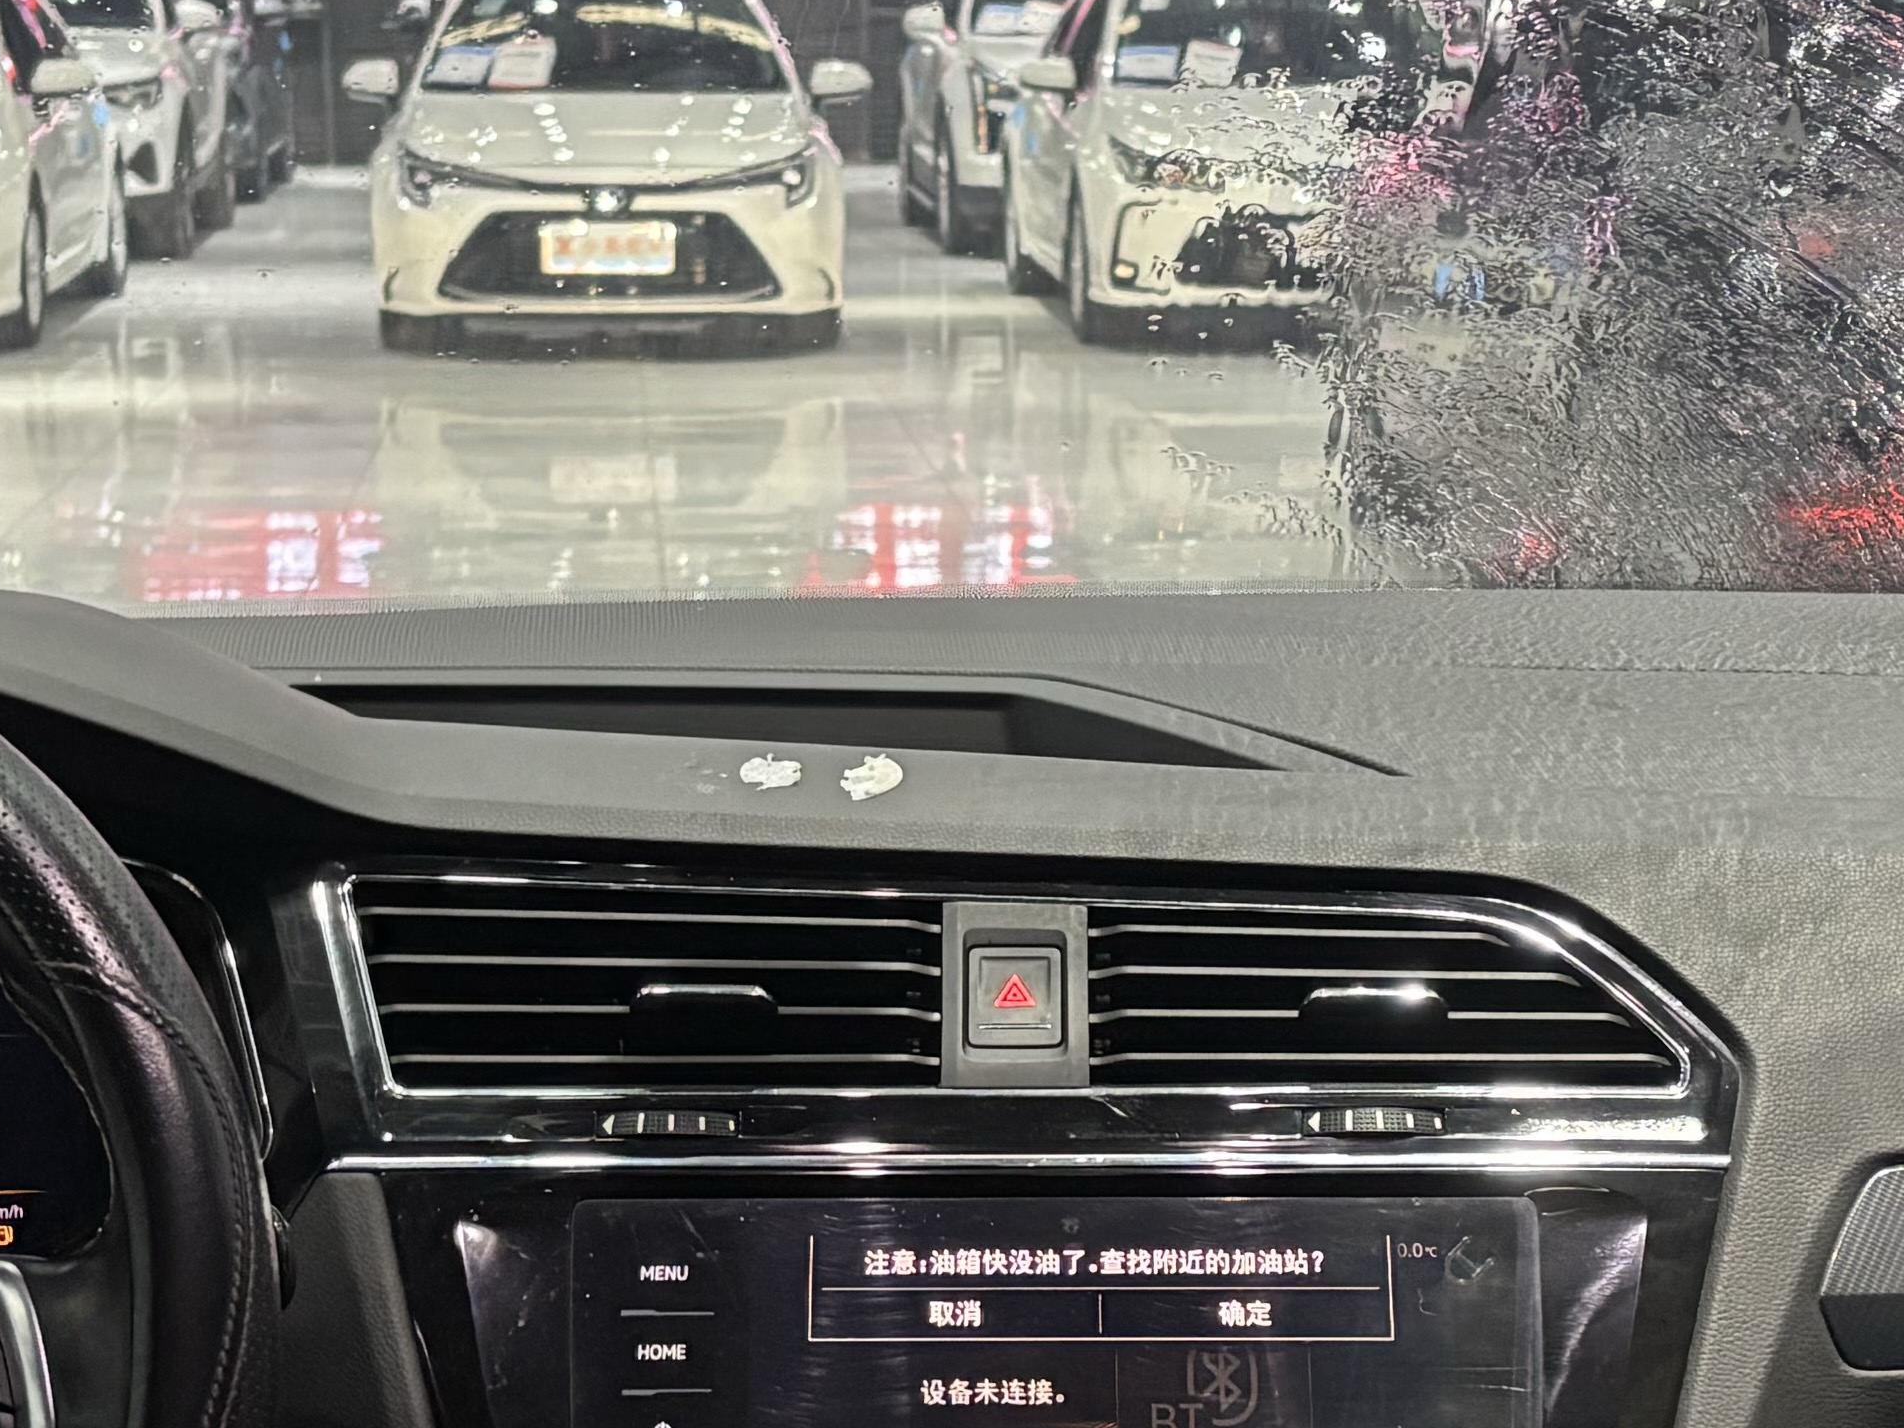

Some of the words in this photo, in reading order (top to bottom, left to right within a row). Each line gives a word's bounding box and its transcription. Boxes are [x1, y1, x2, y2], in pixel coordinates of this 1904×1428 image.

[639, 1264, 689, 1282] MENU
[928, 1299, 983, 1328] 取消
[1217, 1298, 1273, 1328] 确定
[637, 1343, 687, 1361] HOME
[919, 1377, 1067, 1406] 设备未连接。
